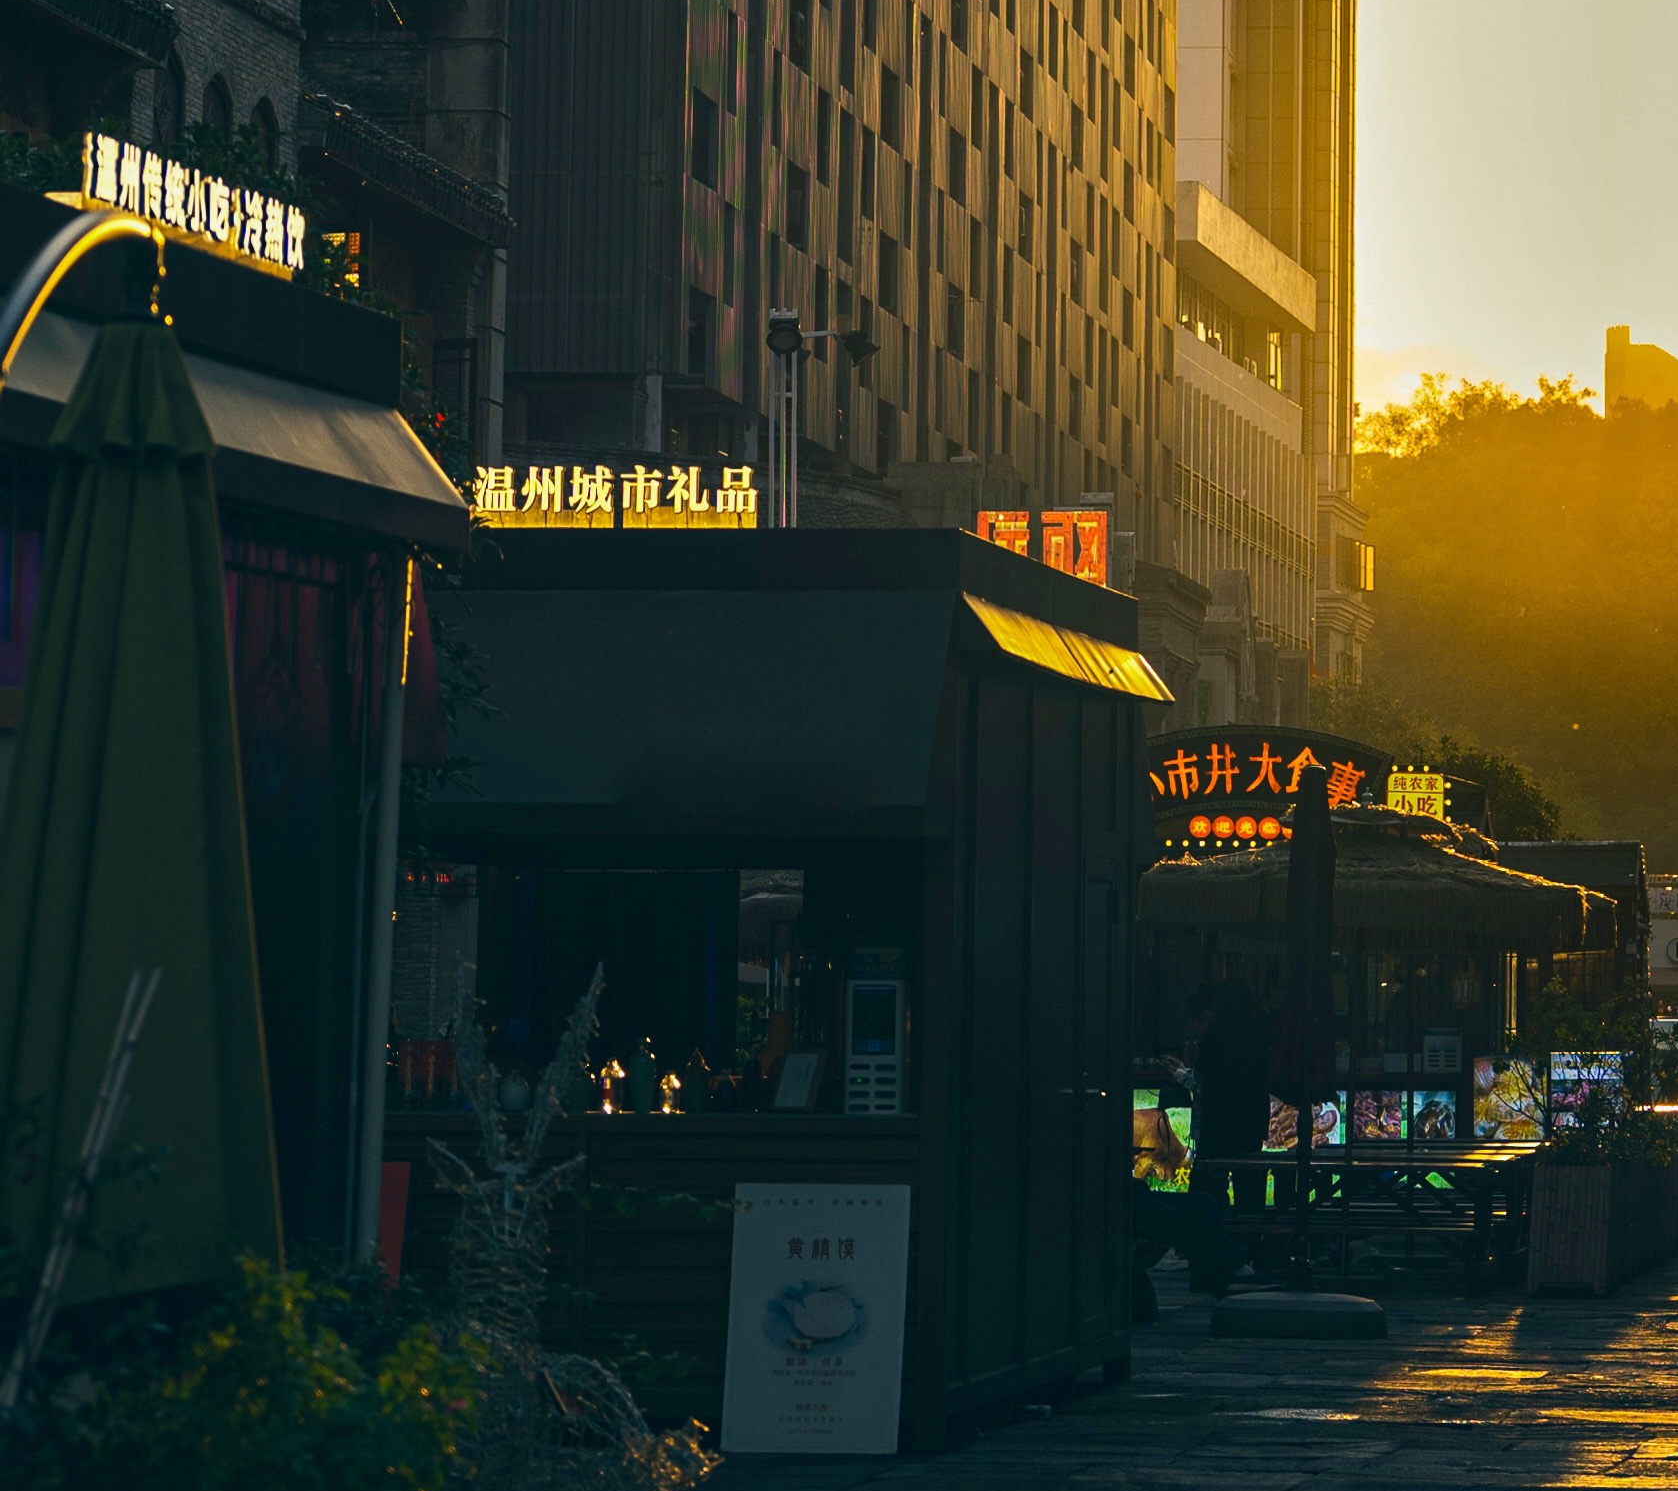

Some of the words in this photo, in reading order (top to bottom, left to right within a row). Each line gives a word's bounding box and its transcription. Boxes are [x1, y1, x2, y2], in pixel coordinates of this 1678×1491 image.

[475, 465, 758, 513] 温州城市礼品
[1149, 742, 1366, 806] 市井大事
[1393, 776, 1439, 791] 纯农家
[1393, 794, 1438, 815] 小吃
[1191, 818, 1280, 836] 欢迎光临
[786, 1236, 856, 1260] 黄精馍
